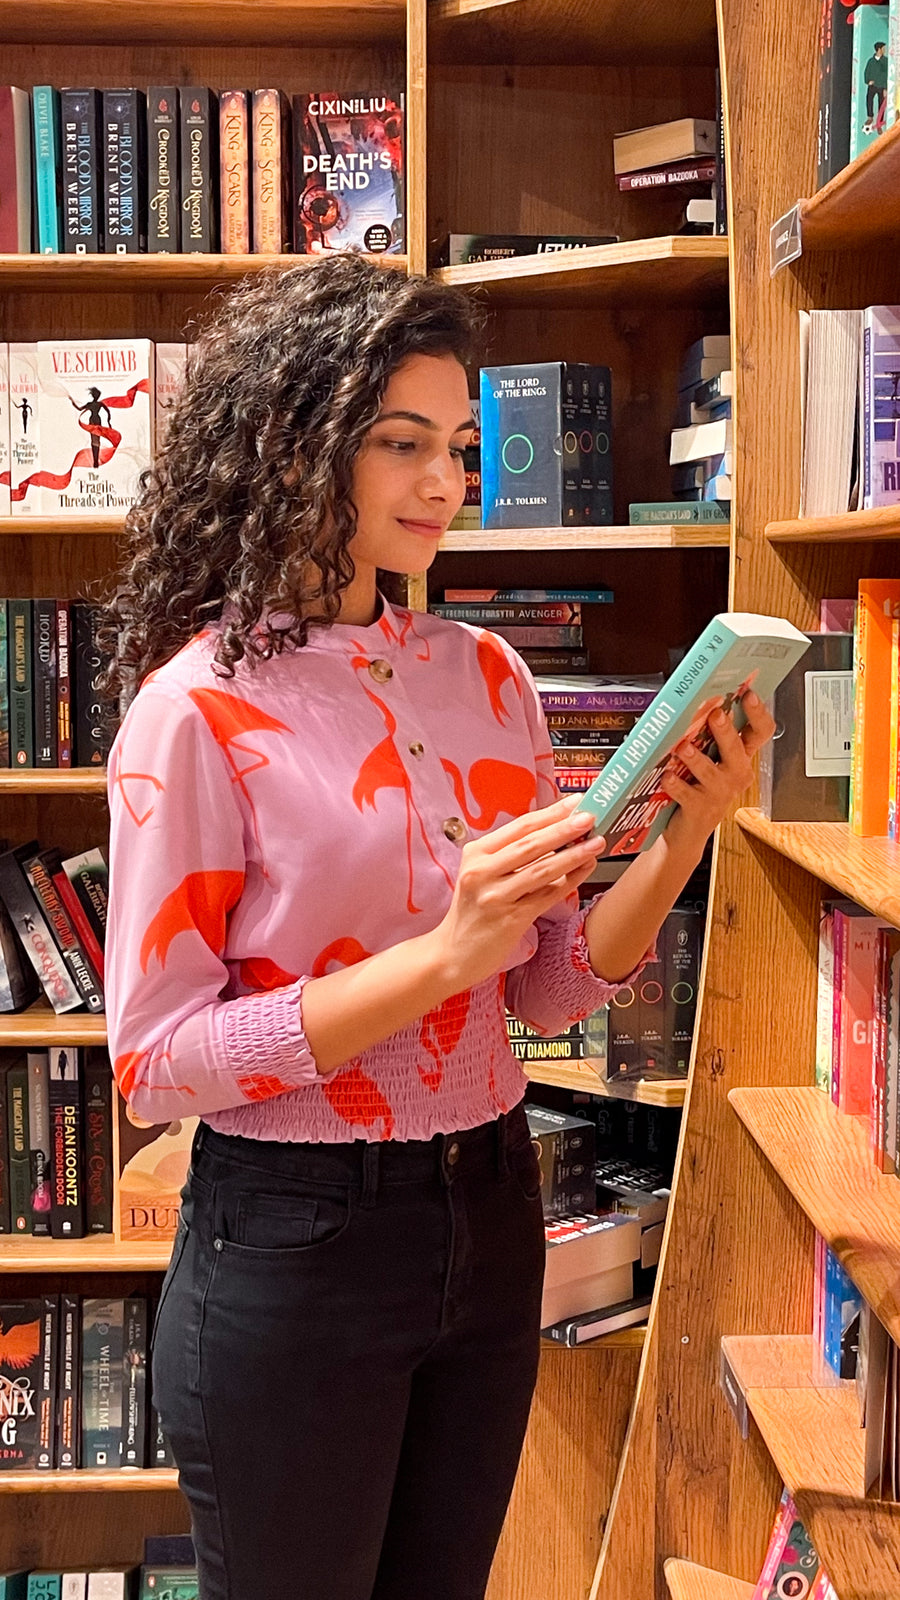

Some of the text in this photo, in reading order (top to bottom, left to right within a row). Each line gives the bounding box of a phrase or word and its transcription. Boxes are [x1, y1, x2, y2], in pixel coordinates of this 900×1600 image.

[38, 92, 48, 124] OLIVIE
[308, 98, 386, 116] CIXIN LIU
[40, 128, 49, 158] BLAKE
[225, 115, 242, 150] KING
[258, 112, 274, 147] KING
[78, 135, 91, 185] BLOOD
[119, 136, 132, 186] BLOOD
[157, 128, 170, 186] CROOKED
[190, 129, 204, 187] CROOKED
[303, 152, 392, 173] DEATH'S
[66, 122, 79, 236] BRENT WEEKS
[108, 123, 120, 236] BRENT WEEKS
[225, 162, 242, 207] SCARS
[258, 160, 274, 204] SCARS
[326, 172, 370, 191] END
[630, 170, 698, 188] OPERATION BAZOOKA
[79, 186, 92, 236] MIRROR
[120, 186, 134, 236] MIRROR
[150, 189, 170, 238] KINGDOM
[183, 190, 203, 238] KINGDOM
[11, 384, 38, 394] SCHWAB
[493, 387, 547, 399] OF THE RINGS
[500, 378, 540, 389] THE LORD
[13, 450, 34, 458] Threads
[15, 442, 36, 450] Fragile
[78, 480, 116, 496] Fragile
[88, 472, 99, 482] The
[58, 493, 135, 508] Threads of Power
[495, 497, 547, 508] J.R.R. TOLKIEN
[446, 609, 563, 618] FREDERICK FORSYTH AVENGER
[15, 615, 25, 683] THE MAGICIAN'S LAND
[39, 614, 50, 663] HOOKED
[58, 610, 68, 678] OPERATION BAZOOKA
[706, 634, 723, 653] B.K.
[674, 654, 710, 697] BORISON
[548, 696, 645, 706] PRIDE ANA HUANG
[16, 712, 25, 748] GROSSMAN
[567, 716, 589, 724] ANA
[590, 716, 625, 724] HUANG
[628, 701, 676, 770] LOVELIGHT
[554, 753, 606, 762] NA HUANG
[592, 764, 630, 807] FARMS
[609, 800, 669, 834] FARMS
[30, 864, 77, 948] ANCILLARY SWORD
[69, 951, 96, 992] ANN LECKIE
[527, 1042, 571, 1058] DIAMOND
[13, 1088, 24, 1151] THE MAGICIAN'S LAND
[54, 1107, 64, 1205] THE FORBIDDEN DOOR
[65, 1106, 78, 1206] DEAN KOONTZ
[88, 1154, 106, 1206] CROWS
[549, 1221, 616, 1244] TERRY HAYES
[99, 1345, 110, 1390] WHEEL
[99, 1399, 109, 1431] TIME
